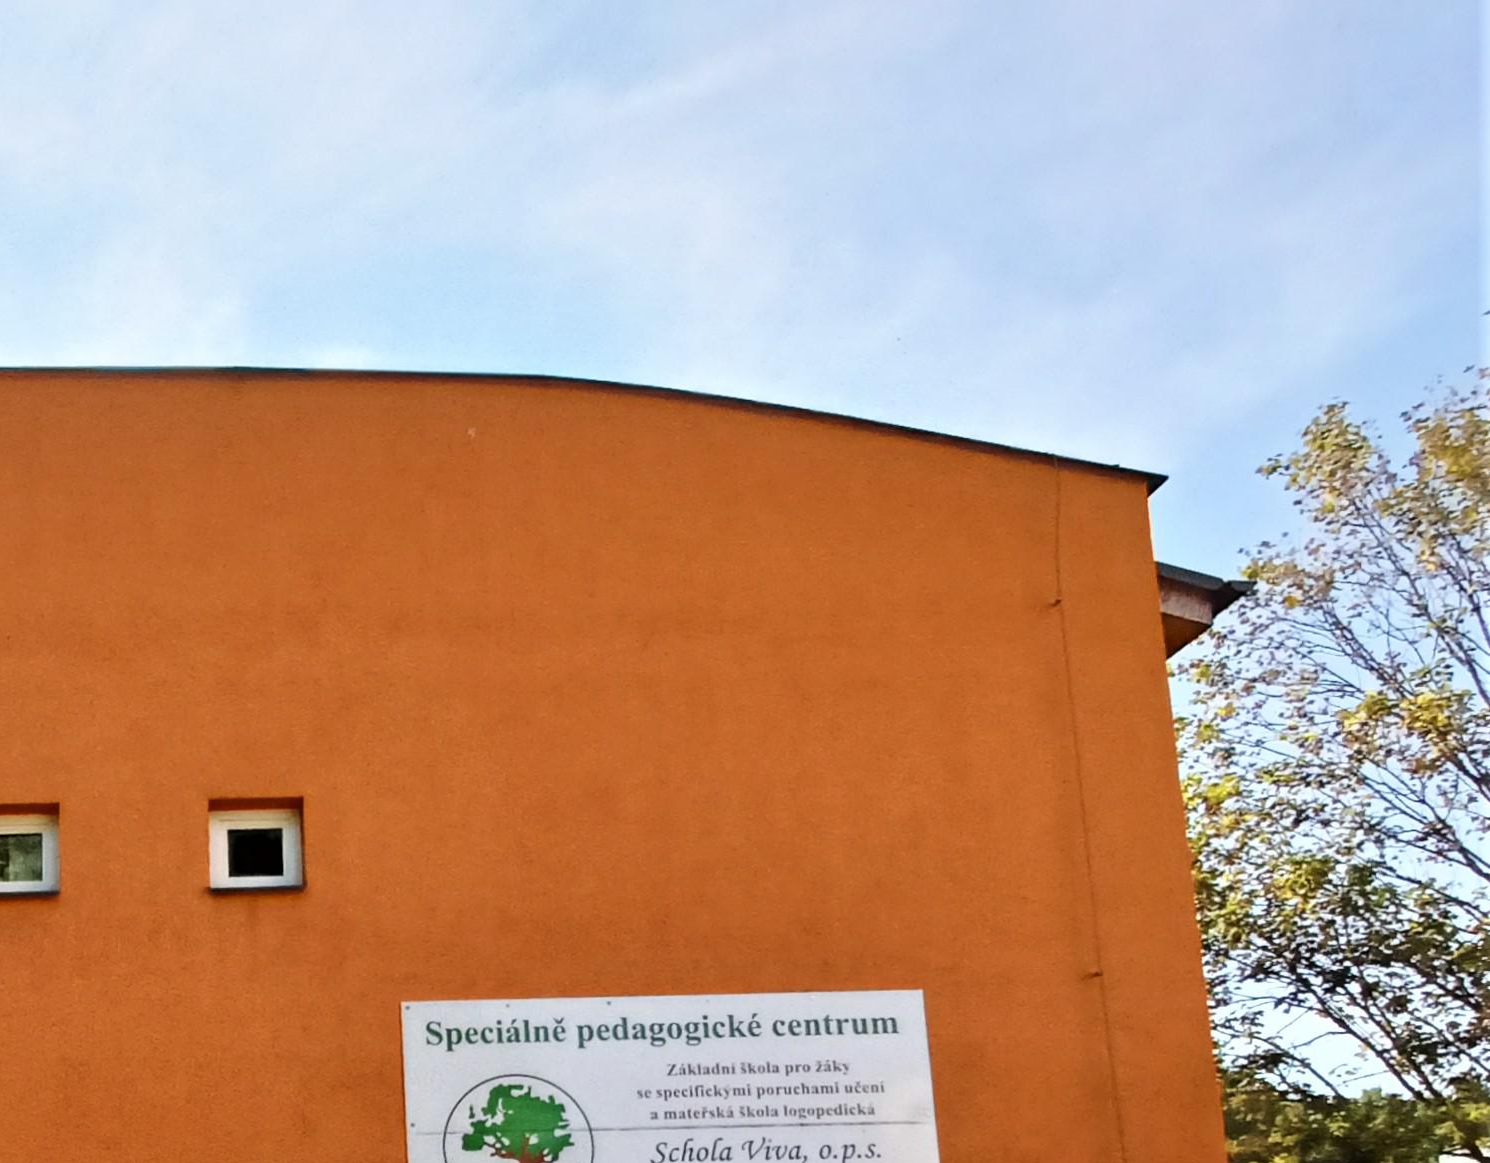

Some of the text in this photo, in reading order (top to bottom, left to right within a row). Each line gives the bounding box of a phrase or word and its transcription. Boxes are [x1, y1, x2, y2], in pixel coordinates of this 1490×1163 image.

[426, 1013, 899, 1052] Speciálně pedagogické centrum
[667, 1059, 849, 1077] Základní škola pro žáky
[637, 1080, 885, 1102] se specifickými poruchami učení
[650, 1101, 876, 1120] a mateřská škola logopedická
[741, 1136, 808, 1163] Viva,
